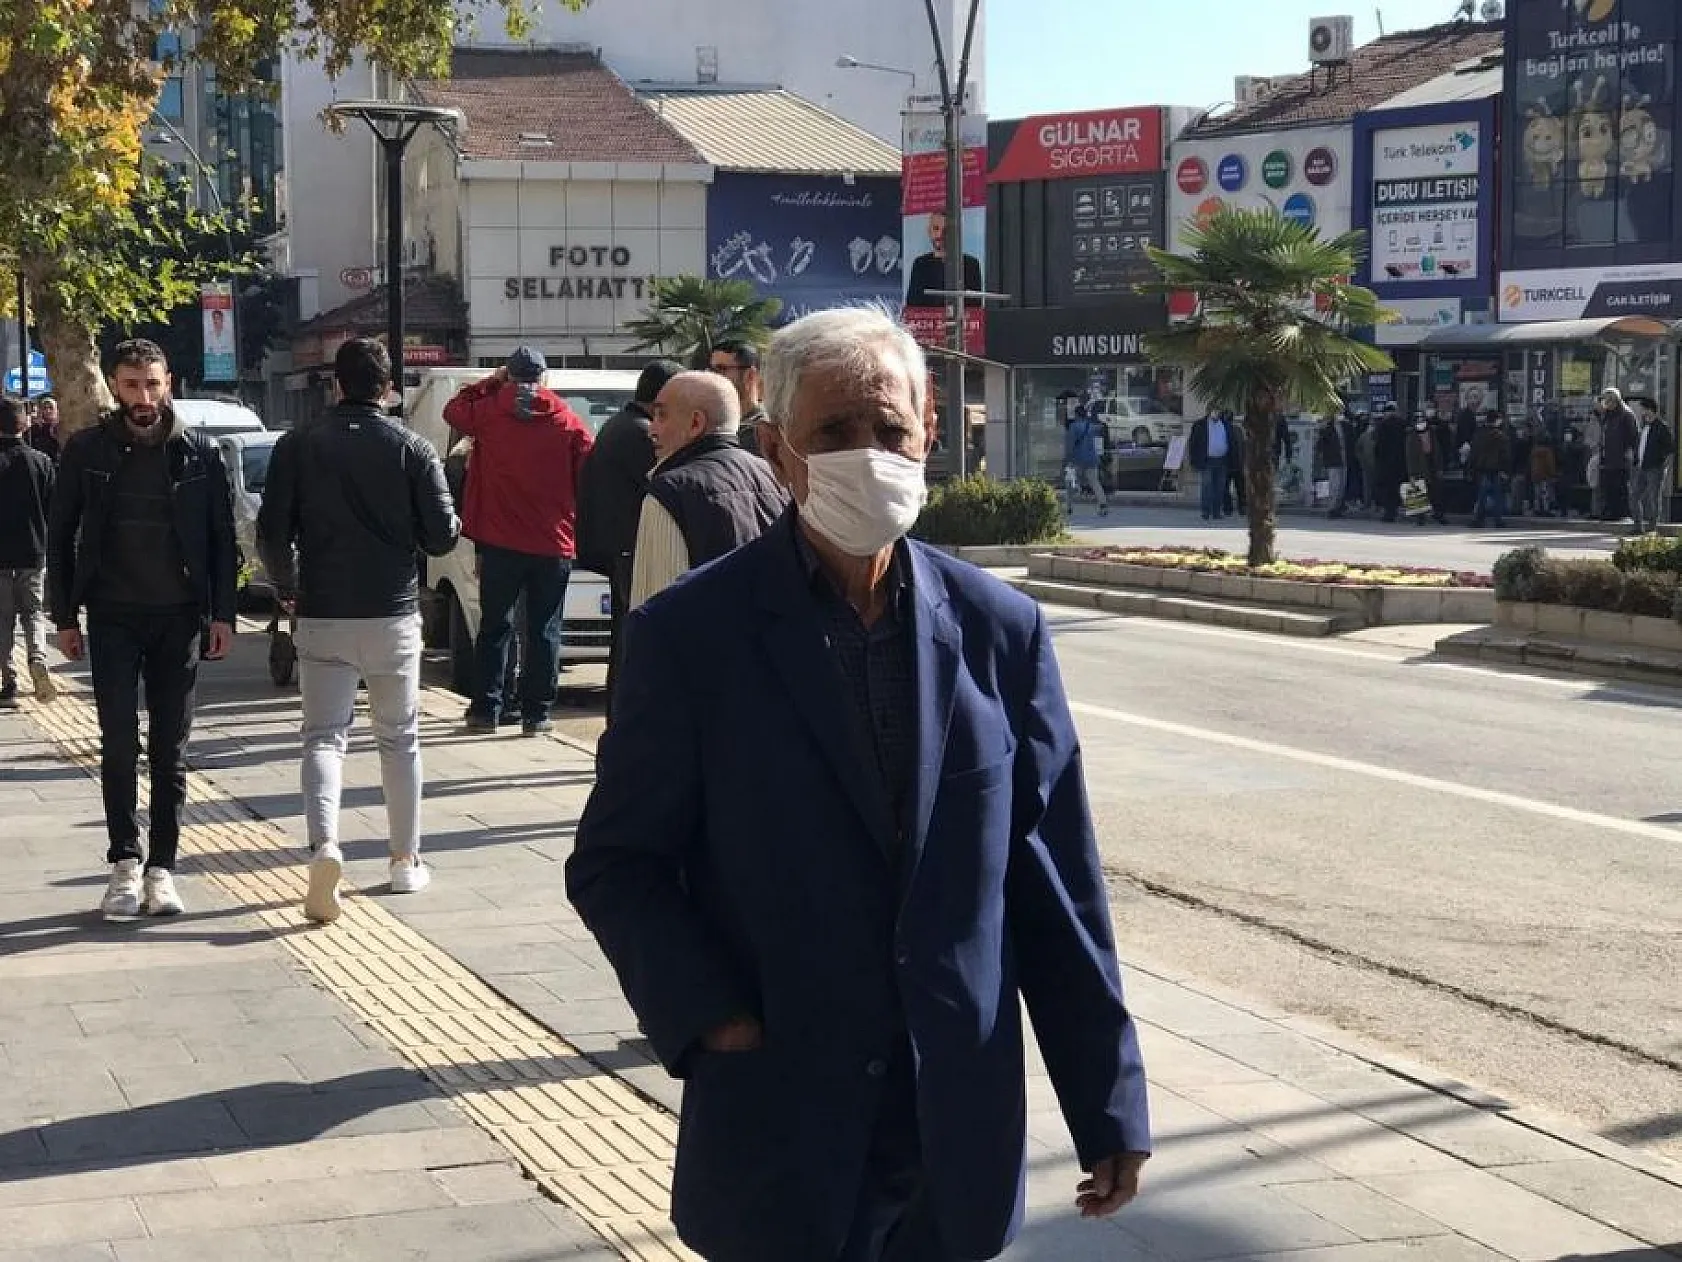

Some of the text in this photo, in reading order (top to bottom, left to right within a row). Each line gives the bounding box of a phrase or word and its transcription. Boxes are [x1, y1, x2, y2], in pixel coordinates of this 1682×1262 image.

[1040, 118, 1140, 147] GÜLNAR
[1377, 182, 1418, 201] DURU
[1460, 206, 1477, 220] VA
[549, 246, 631, 267] FOTO
[505, 277, 656, 299] SELAHATT
[1523, 286, 1587, 303] TURKCELL
